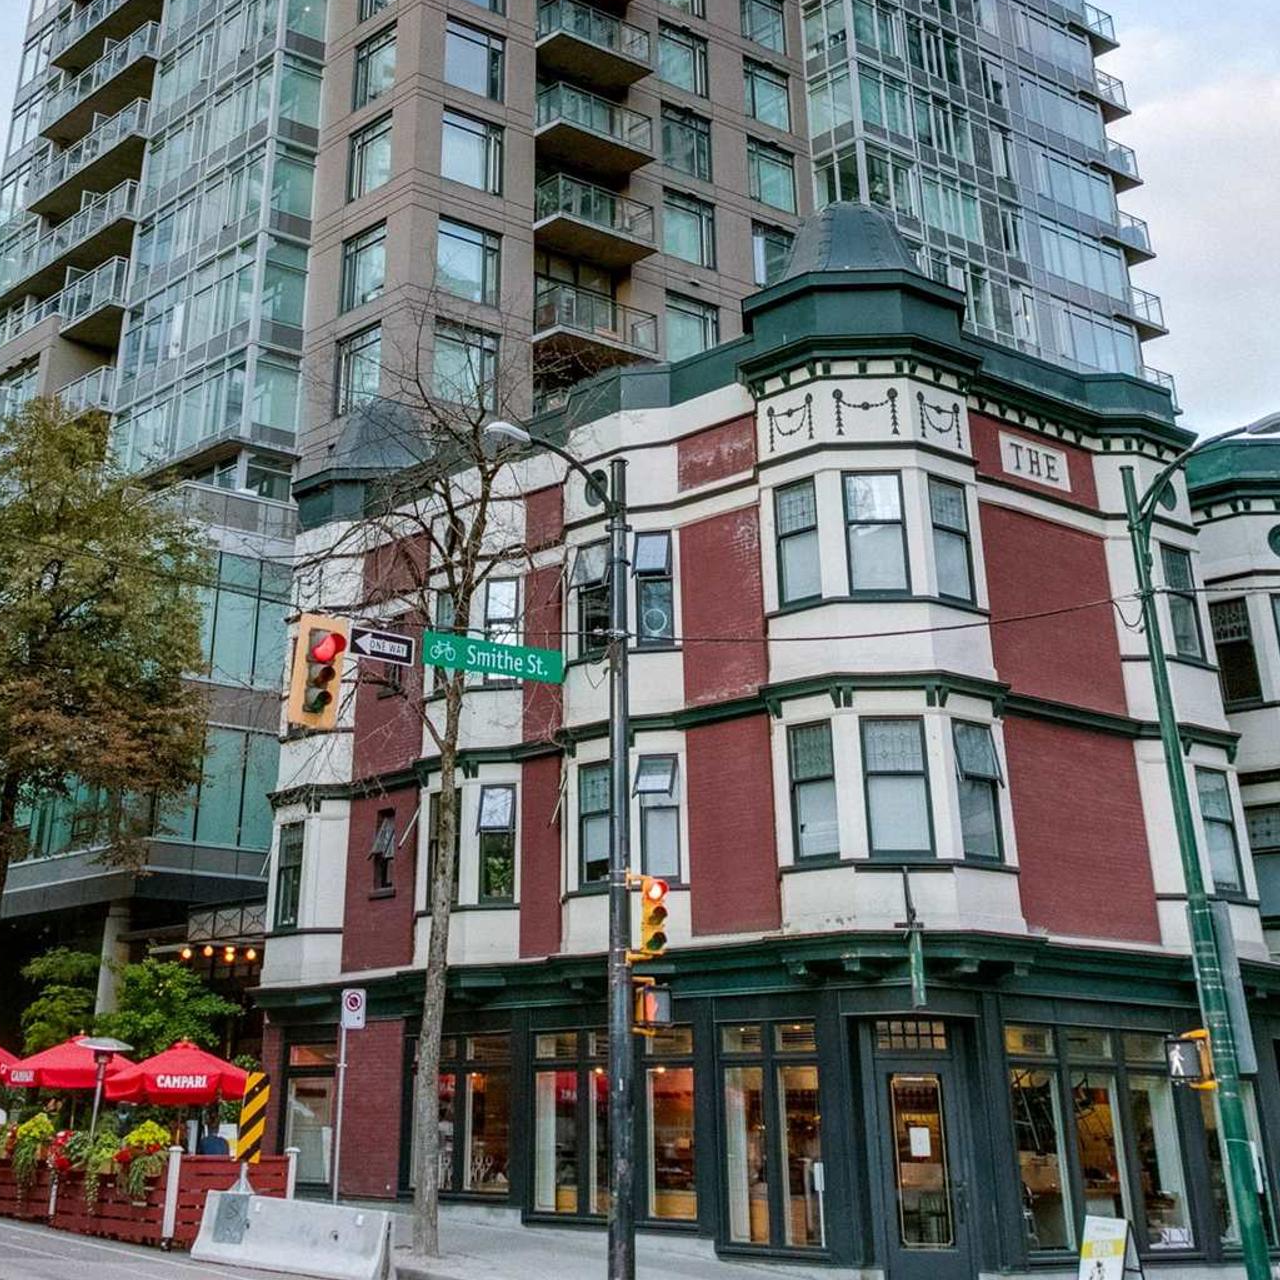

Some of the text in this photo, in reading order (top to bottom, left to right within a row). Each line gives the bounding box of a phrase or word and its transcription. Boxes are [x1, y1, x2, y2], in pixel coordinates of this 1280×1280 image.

[1010, 442, 1059, 481] THE
[369, 639, 406, 656] ONE WAY
[466, 644, 549, 676] Smithe St.
[156, 1074, 207, 1089] CAMPARI
